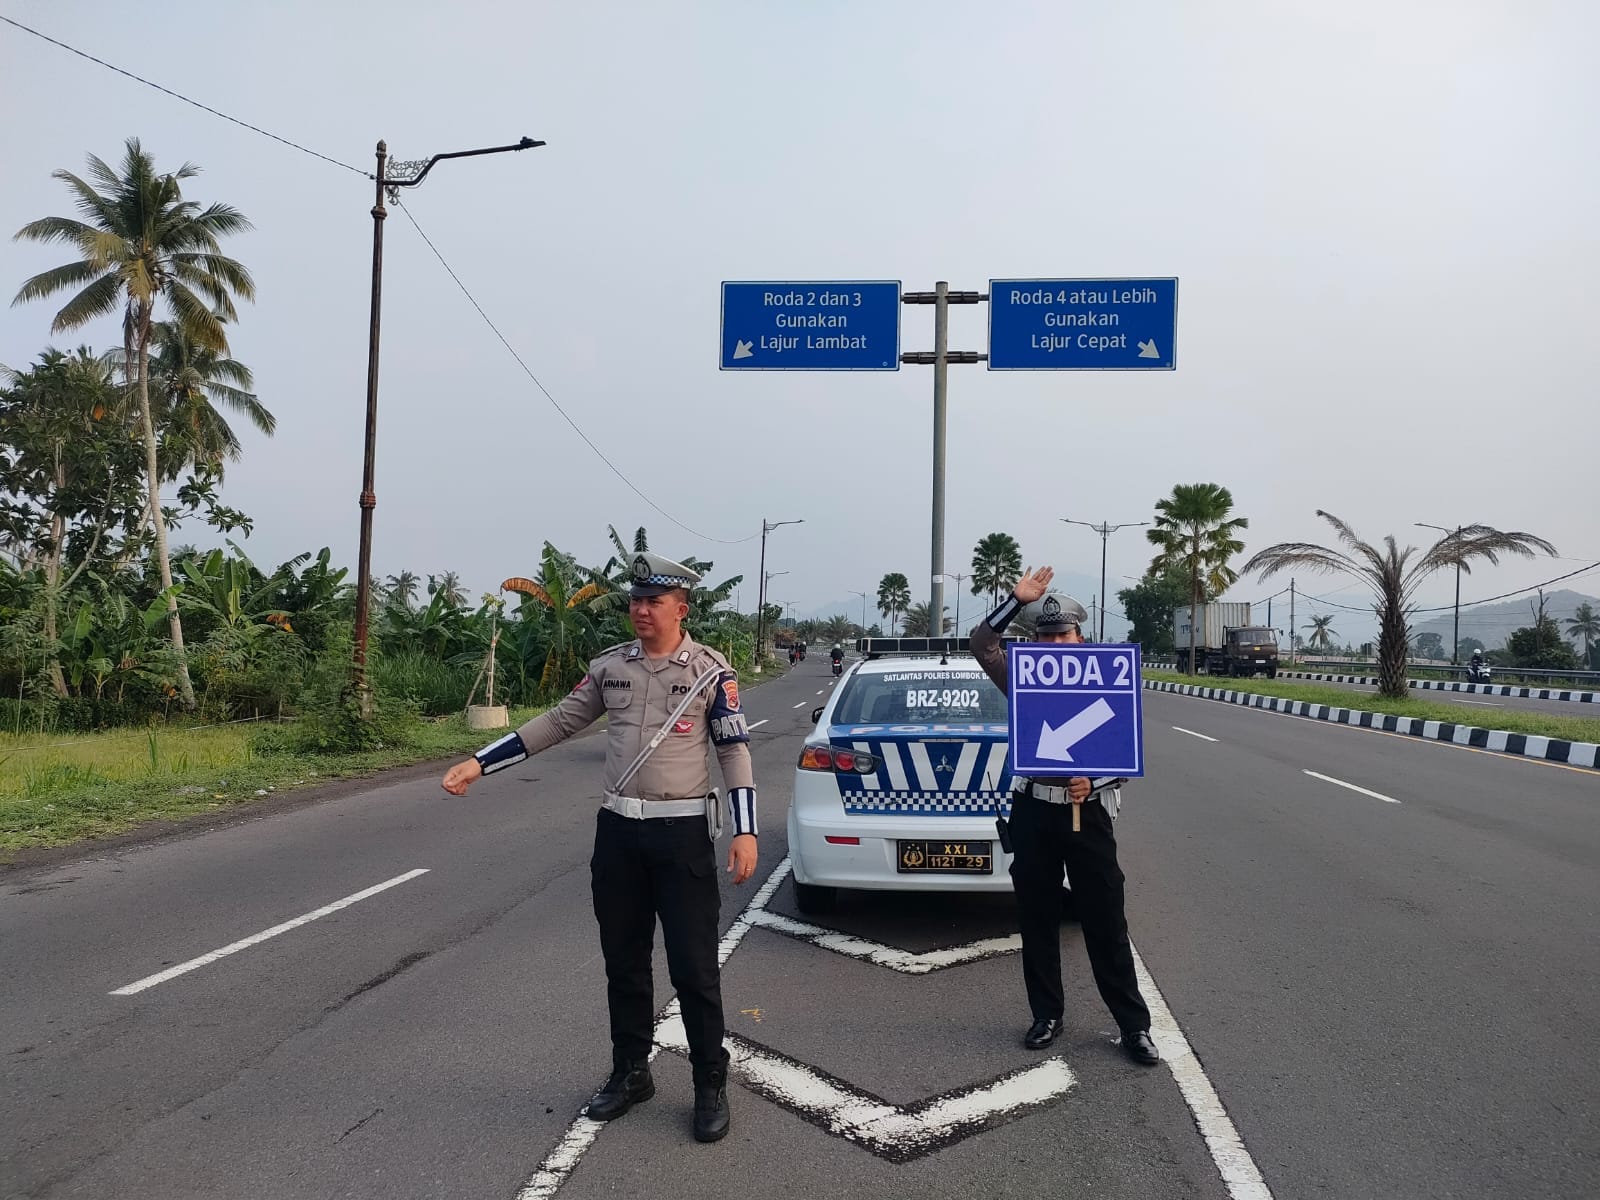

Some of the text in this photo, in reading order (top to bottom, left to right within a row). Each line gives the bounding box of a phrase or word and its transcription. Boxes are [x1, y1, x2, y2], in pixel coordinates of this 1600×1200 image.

[764, 291, 862, 307] Roda 2 dan 3
[1010, 288, 1157, 305] Roda 4 atau Lebih
[776, 313, 847, 328] Gunakan
[1044, 311, 1119, 327] Gunakan
[760, 334, 867, 353] Lajur Lambat
[1031, 333, 1127, 352] Lajur Cepat
[883, 672, 922, 682] SATLANTAS
[923, 671, 950, 680] POLRES
[951, 671, 981, 680] LOMBOK
[1018, 654, 1130, 686] RODA 2
[906, 689, 980, 708] BRZ-9202
[944, 844, 967, 855] XXI
